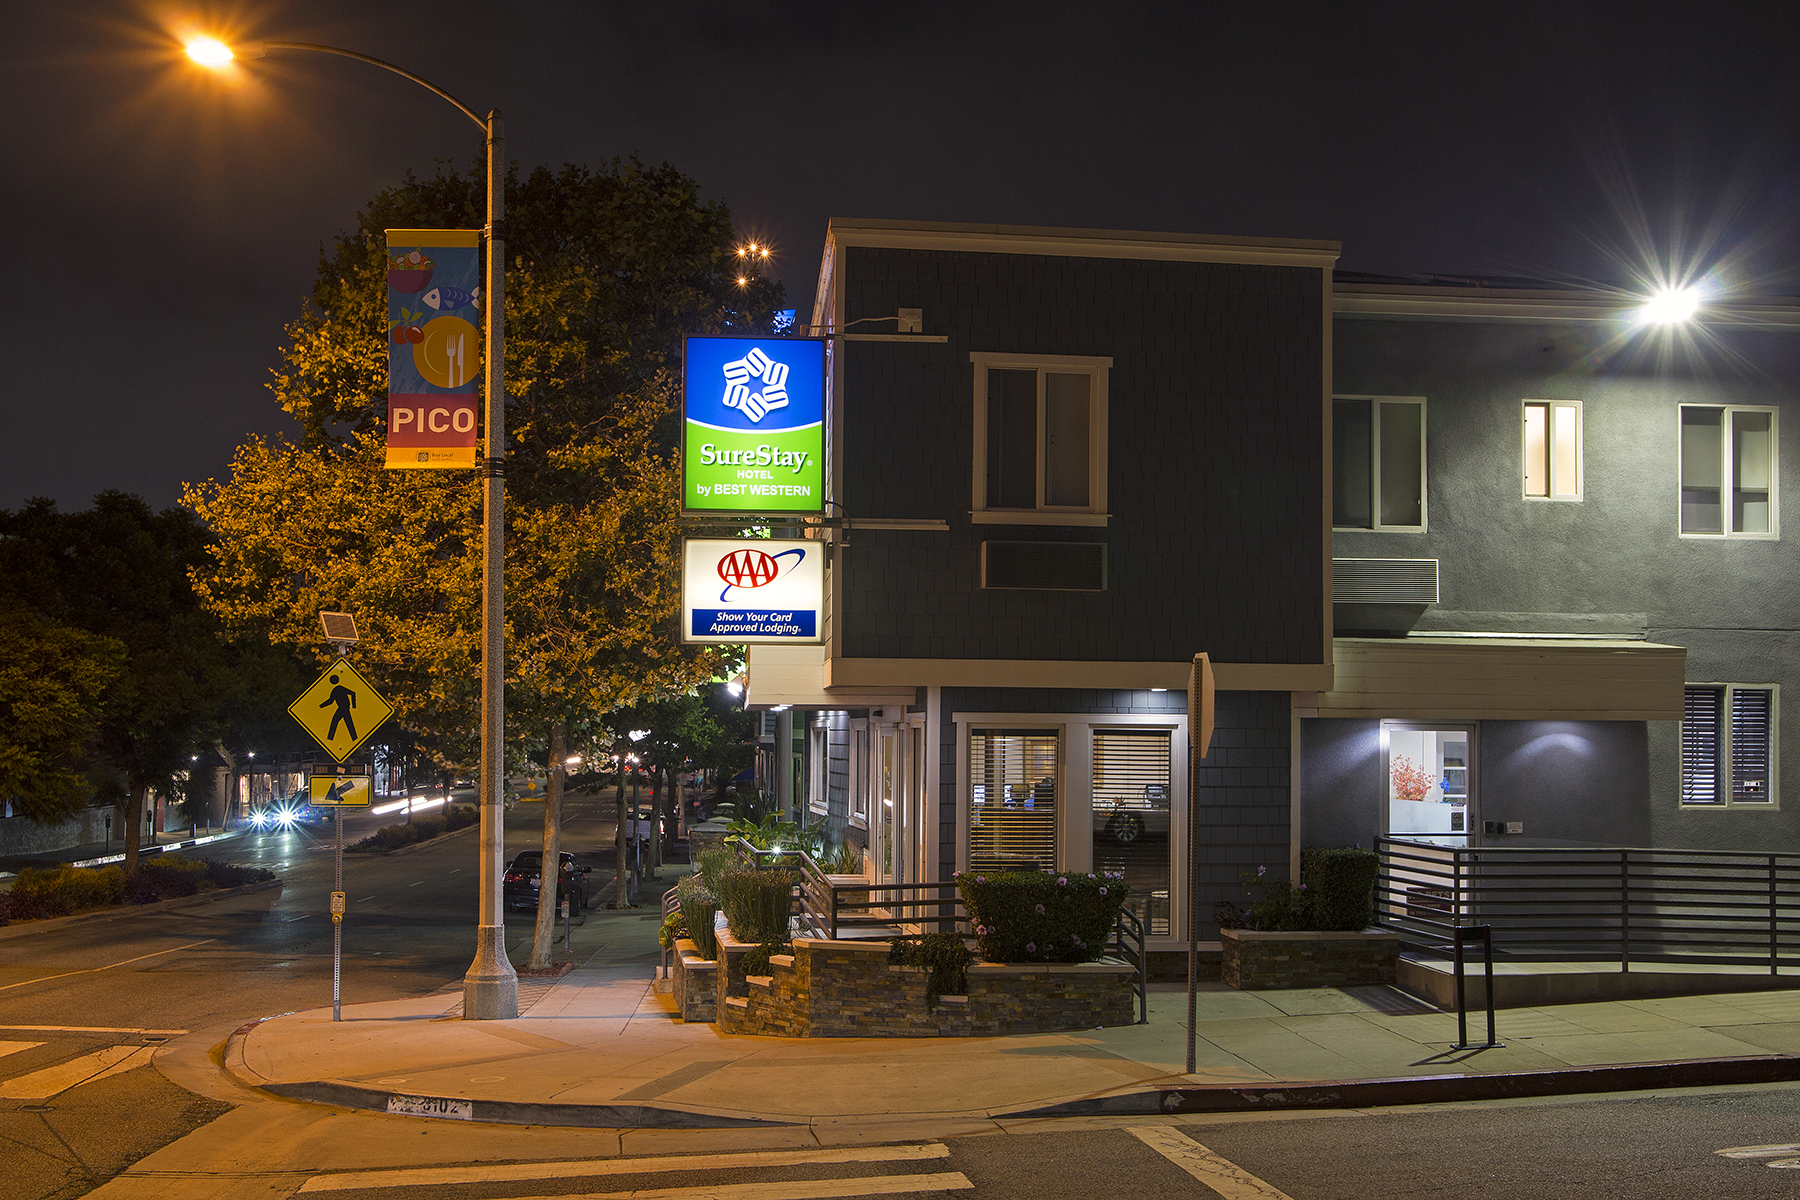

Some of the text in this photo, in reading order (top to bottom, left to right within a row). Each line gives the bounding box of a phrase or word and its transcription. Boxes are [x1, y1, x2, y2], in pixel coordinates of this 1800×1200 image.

[392, 407, 475, 433] PICO
[737, 470, 773, 479] HOTEL
[696, 483, 811, 497] by BEST WESTERN
[721, 549, 775, 588] AAA
[716, 612, 793, 622] Show Your Card
[710, 622, 758, 633] Approved
